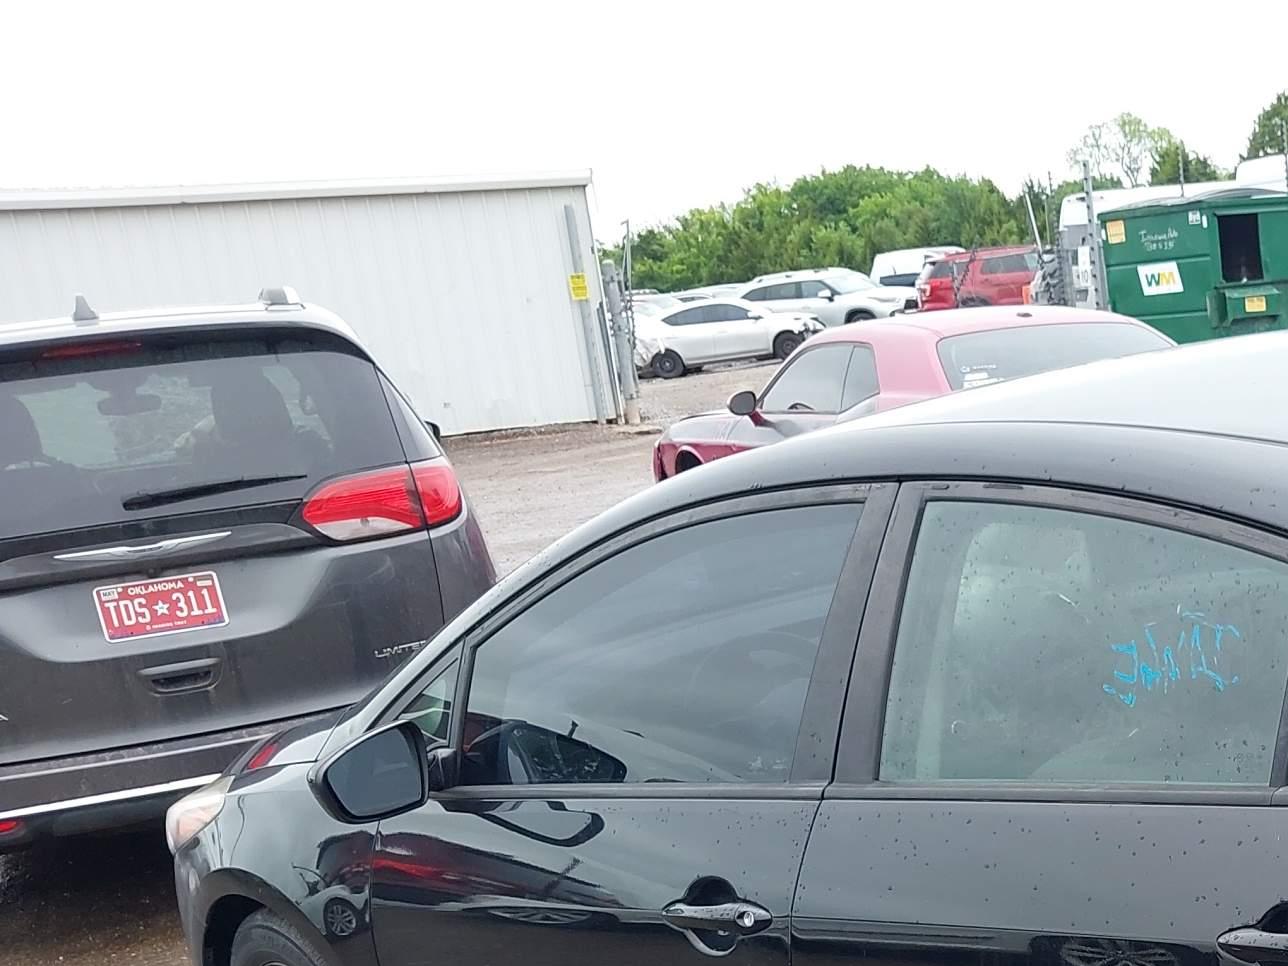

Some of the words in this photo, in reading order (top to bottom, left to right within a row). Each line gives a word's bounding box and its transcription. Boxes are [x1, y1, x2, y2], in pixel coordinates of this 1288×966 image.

[1145, 271, 1176, 287] WM
[127, 580, 185, 596] OKLAHOMA
[103, 597, 151, 628] TDS
[171, 588, 218, 618] 311
[374, 640, 426, 658] LIMITE
